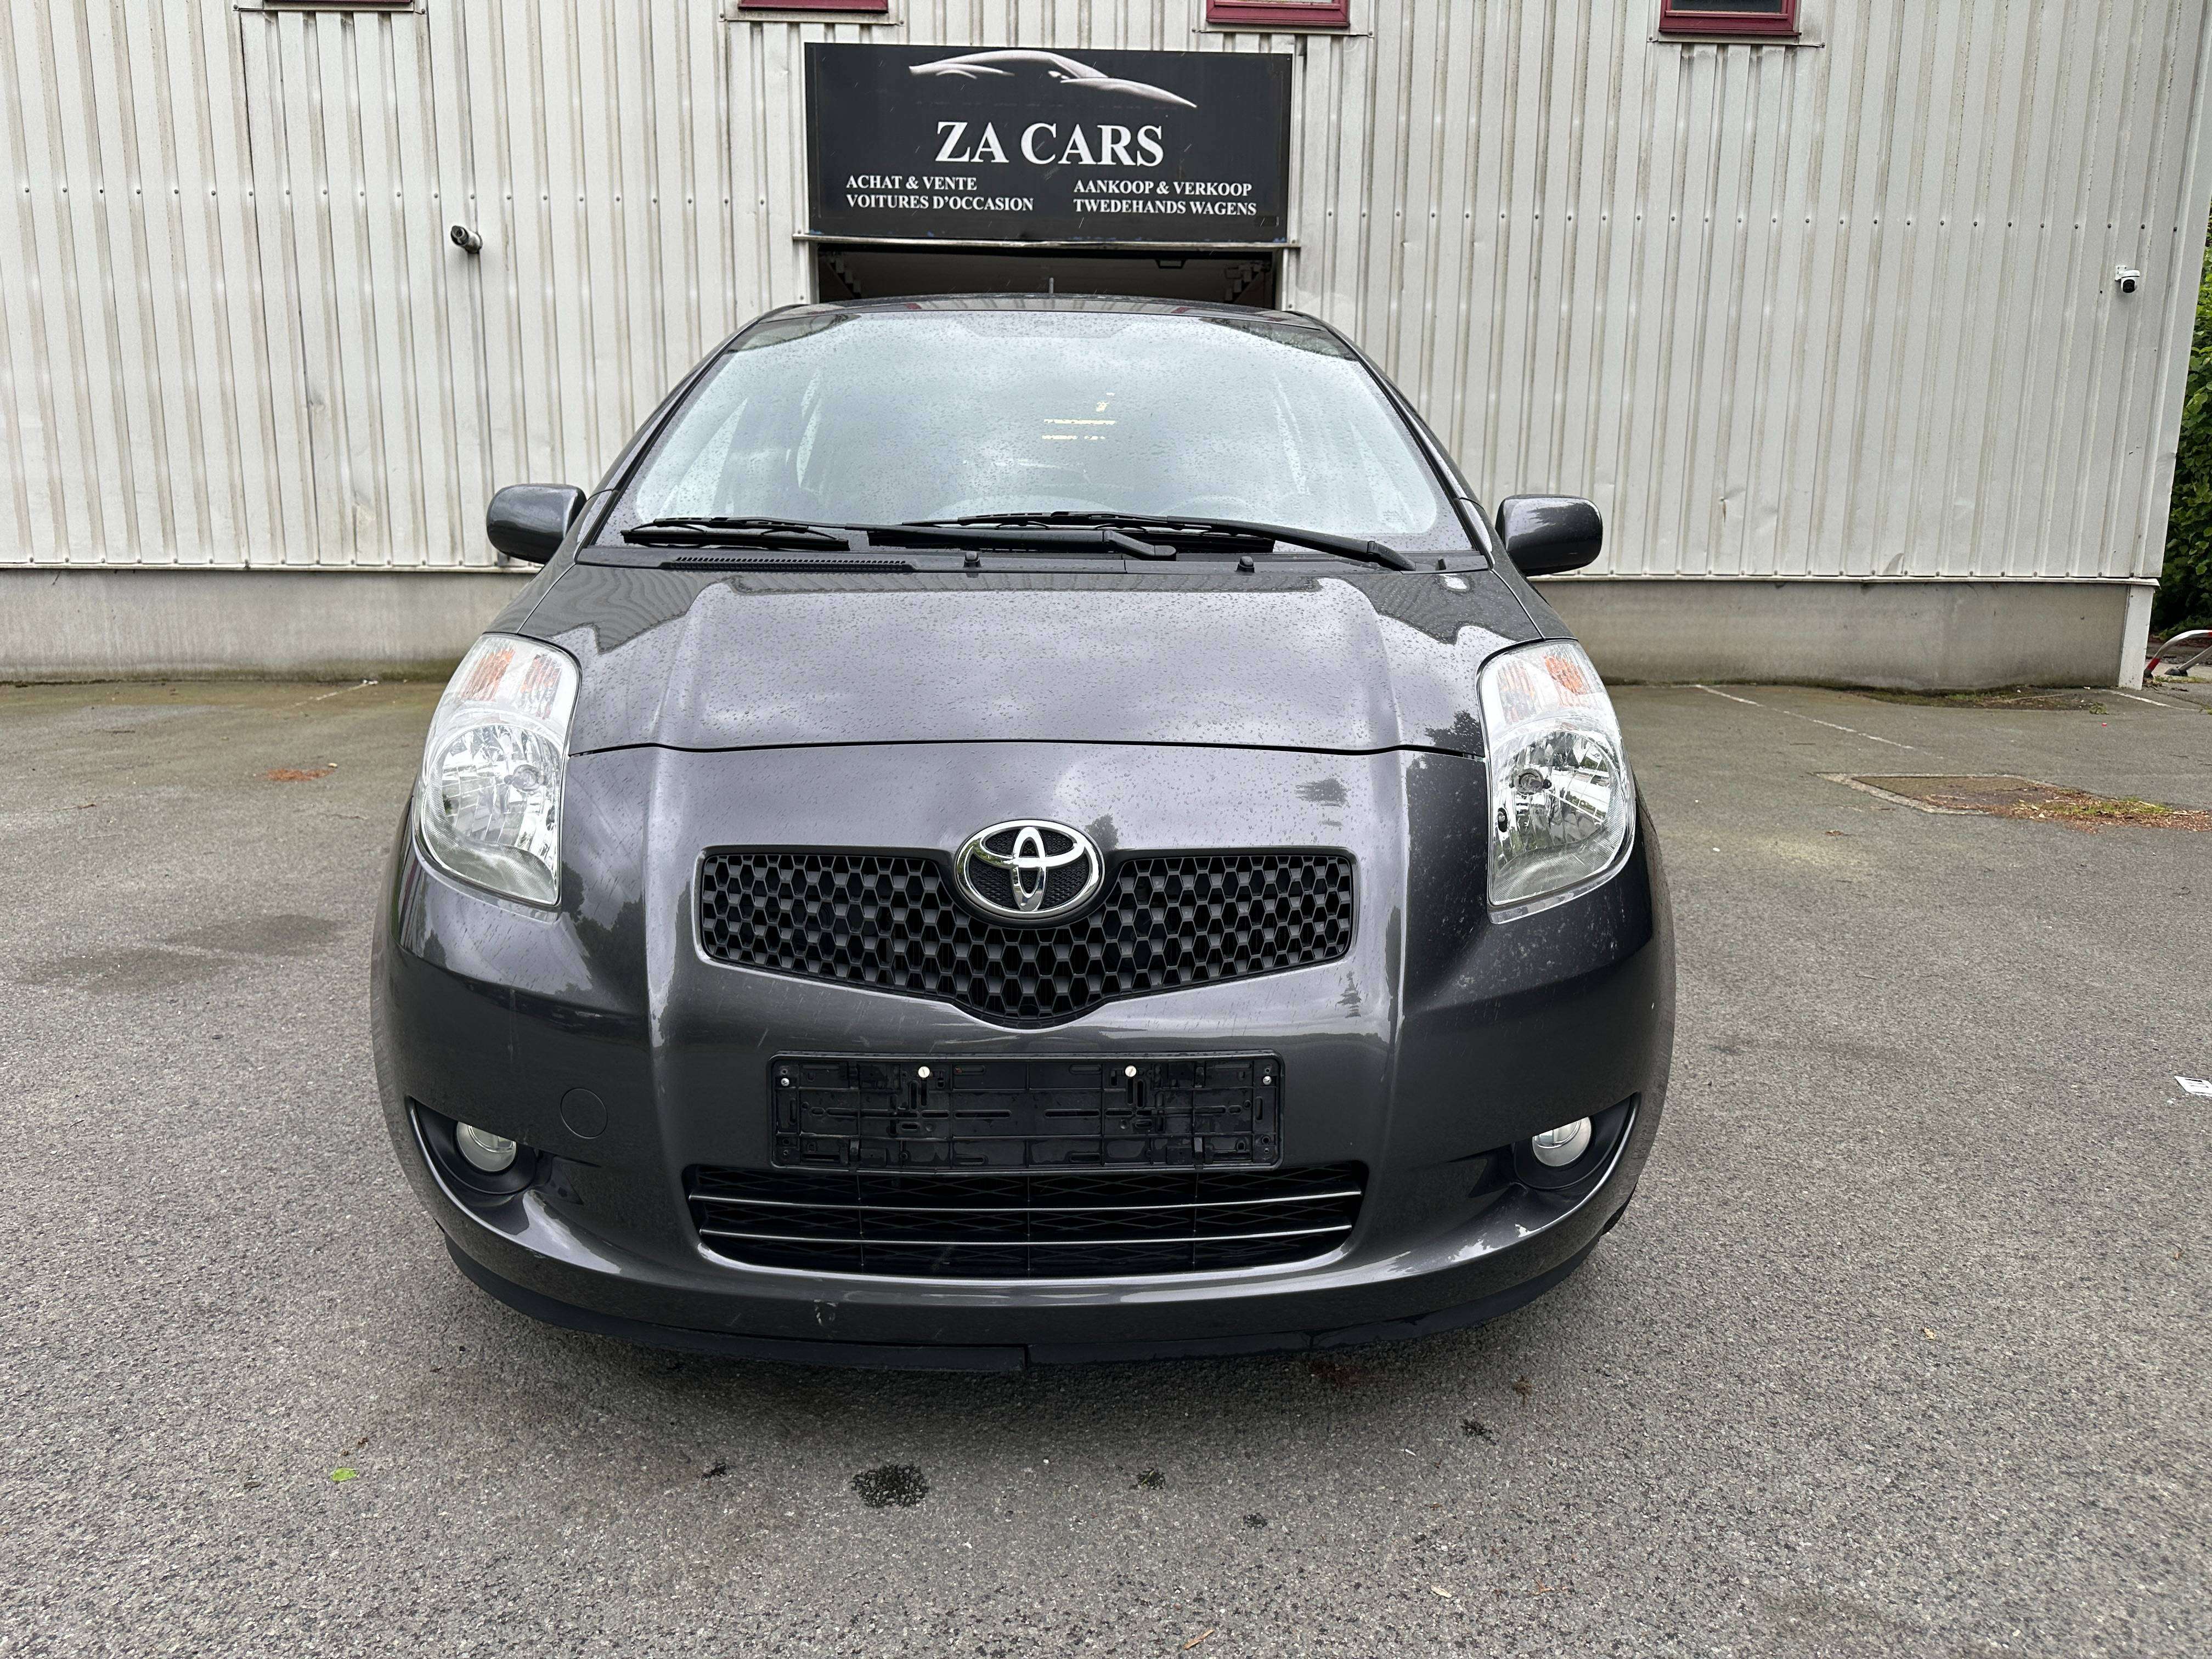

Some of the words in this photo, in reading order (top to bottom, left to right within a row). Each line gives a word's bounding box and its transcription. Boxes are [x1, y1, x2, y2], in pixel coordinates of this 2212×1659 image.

[935, 121, 1010, 163] ZA
[1020, 122, 1164, 167] CARS
[846, 174, 903, 189] ACHAT
[906, 176, 919, 190] &
[923, 176, 978, 190] VENTE
[1074, 179, 1154, 194] AANKOOP
[1156, 180, 1170, 195] &
[1173, 181, 1252, 196] VERKOOP
[846, 194, 929, 209] VOITURES
[933, 195, 1034, 211] D'OCCASION
[1073, 199, 1186, 214] TWEDEHANDS
[1189, 201, 1257, 216] WAGENS
